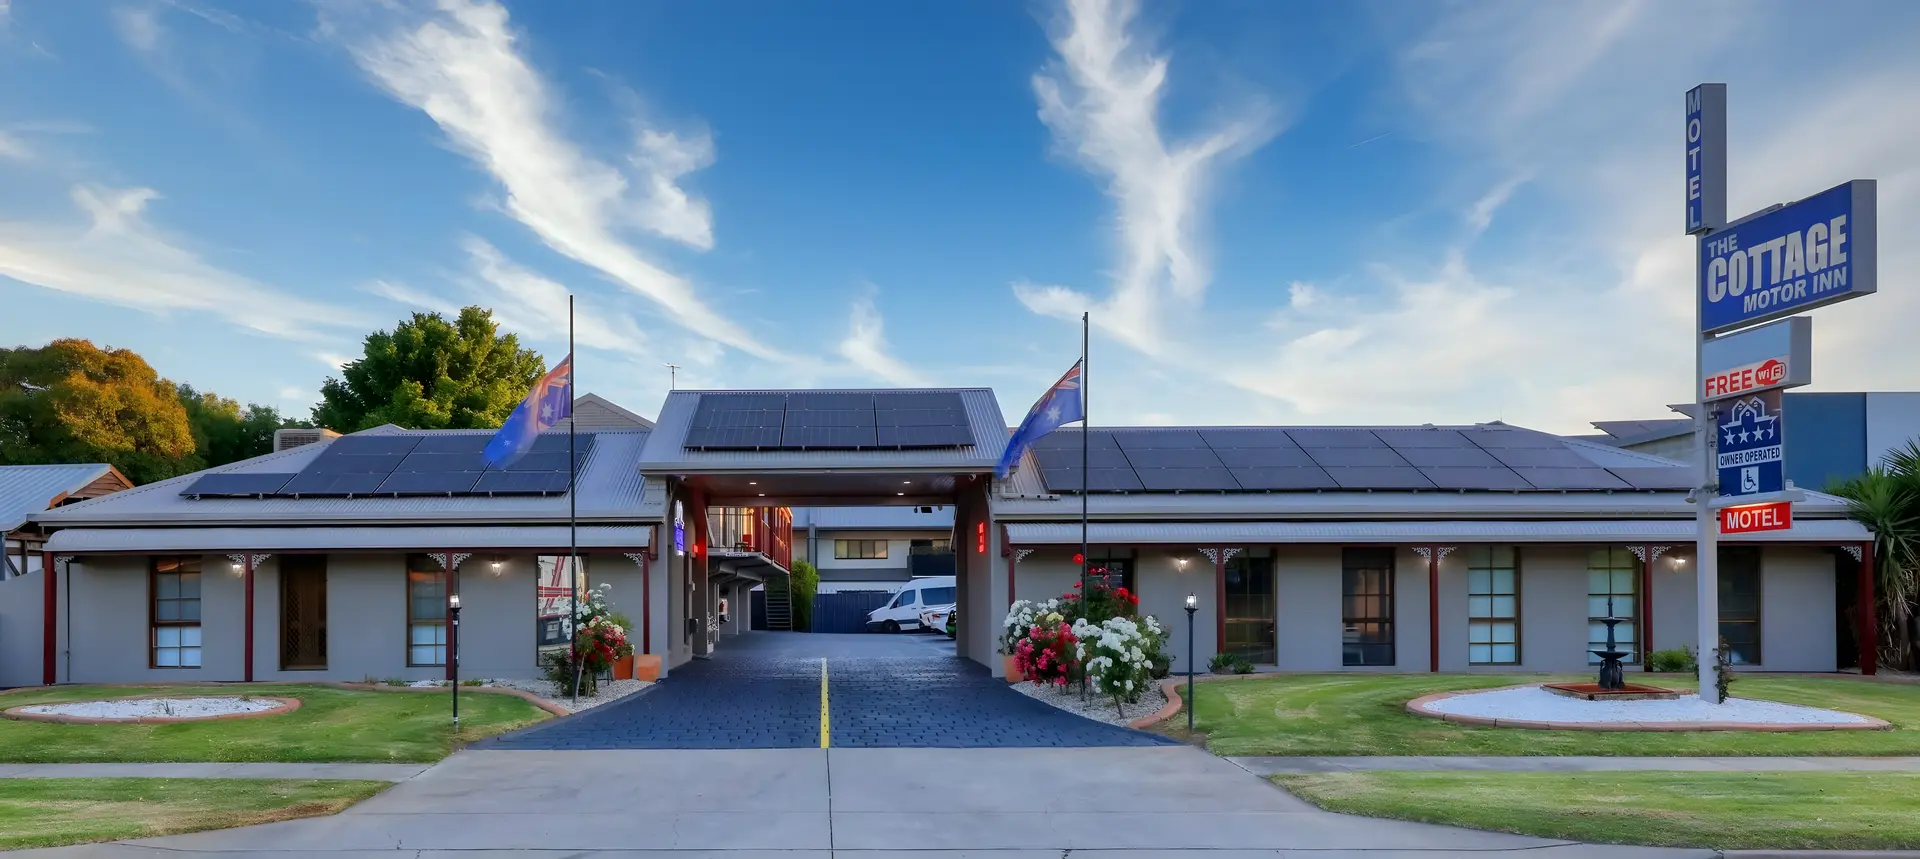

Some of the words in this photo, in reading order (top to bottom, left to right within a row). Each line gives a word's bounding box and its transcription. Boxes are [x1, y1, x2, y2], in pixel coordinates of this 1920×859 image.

[1687, 88, 1700, 229] MOTEL
[1707, 234, 1738, 257] THE
[1707, 214, 1847, 303] COTTAGE
[1743, 279, 1806, 313] MOTOR
[1813, 266, 1847, 294] INN
[1705, 369, 1752, 397] FREE
[1720, 452, 1744, 466] OWNER
[1745, 447, 1780, 462] OPERATED
[1727, 508, 1783, 529] MOTEL
